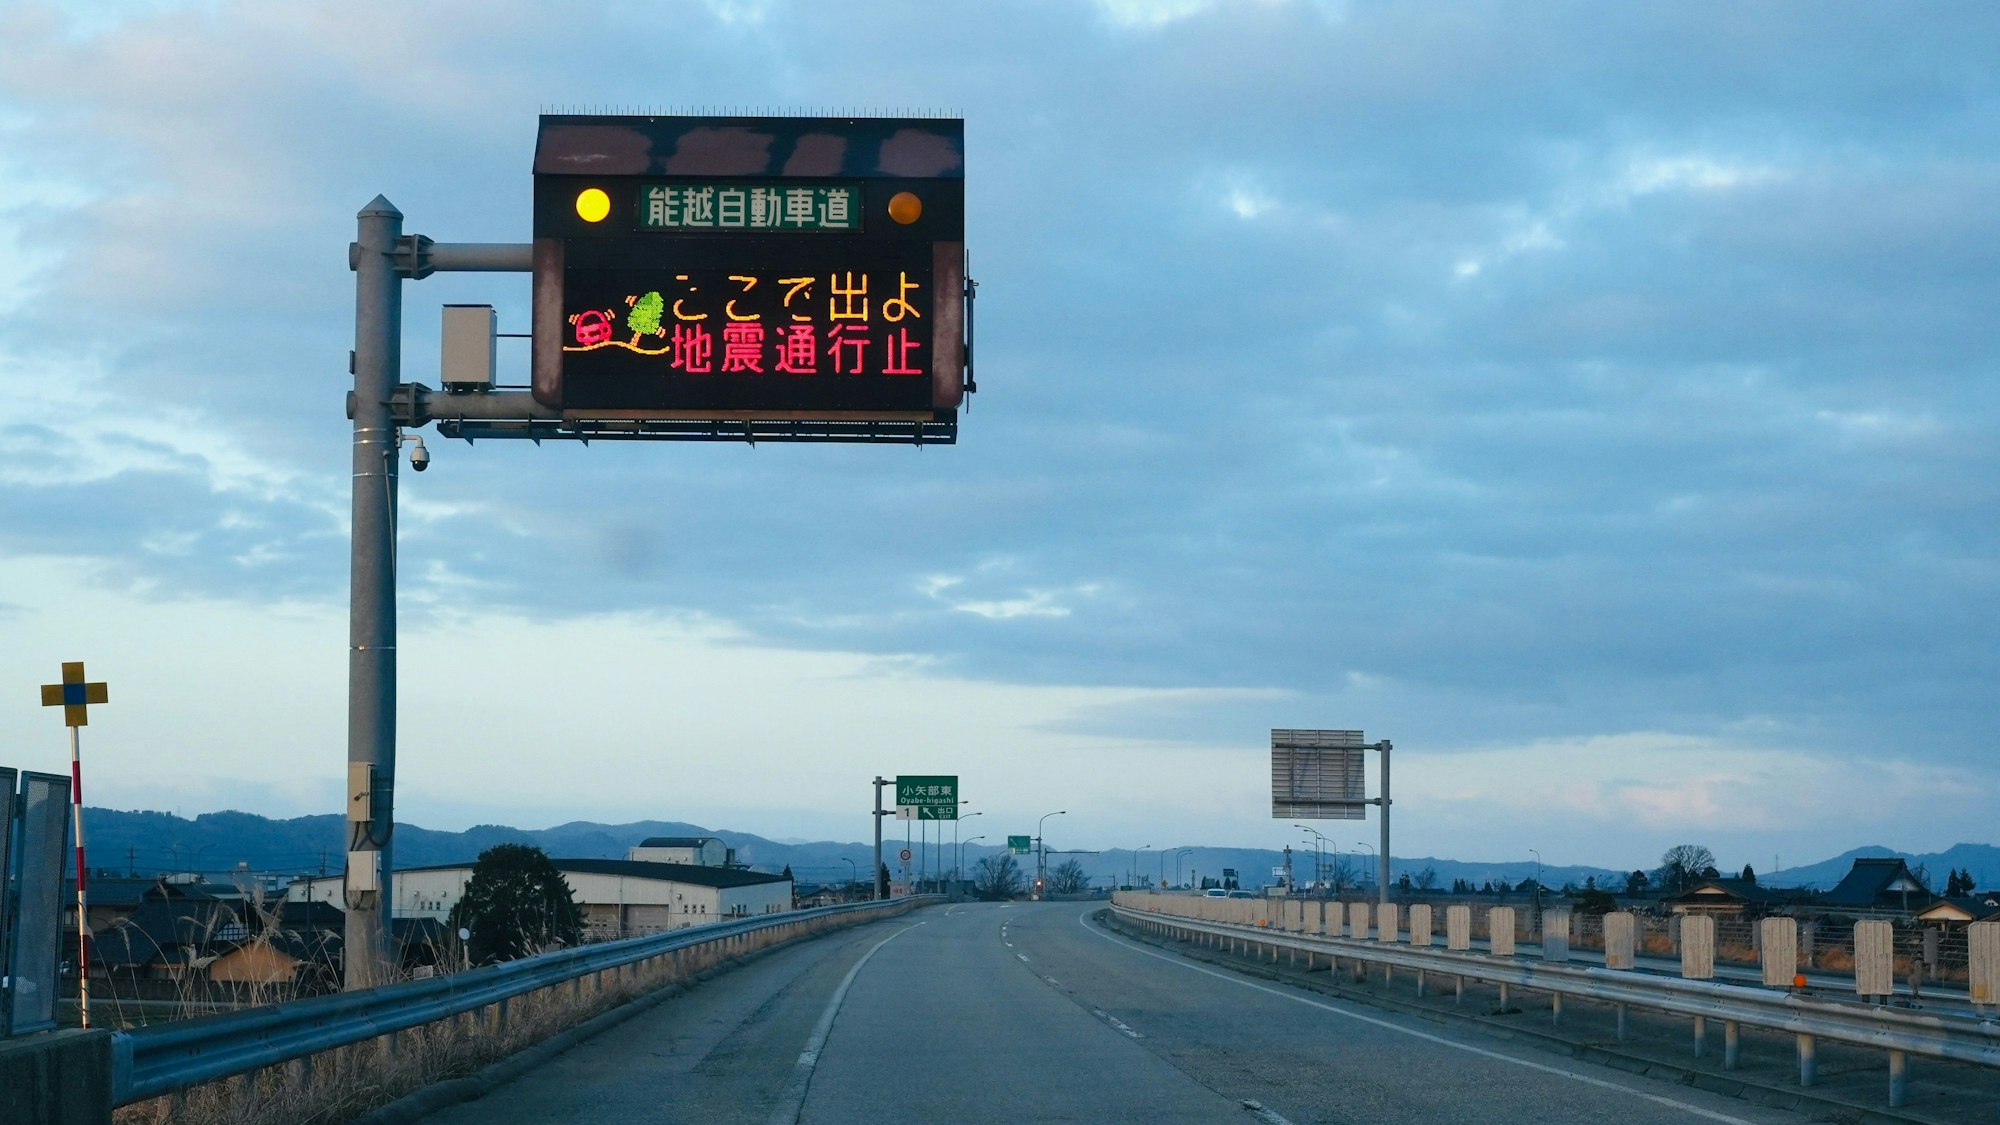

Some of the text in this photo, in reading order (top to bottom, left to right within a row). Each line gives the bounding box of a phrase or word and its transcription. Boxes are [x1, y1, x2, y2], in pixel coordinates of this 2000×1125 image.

[648, 187, 850, 228] 能越自動車道
[673, 271, 921, 322] ここで出よ
[671, 322, 922, 375] 地震通行止
[900, 797, 954, 805] Oyabe-higashi
[902, 785, 952, 796] 小矢部東
[904, 808, 910, 817] 1
